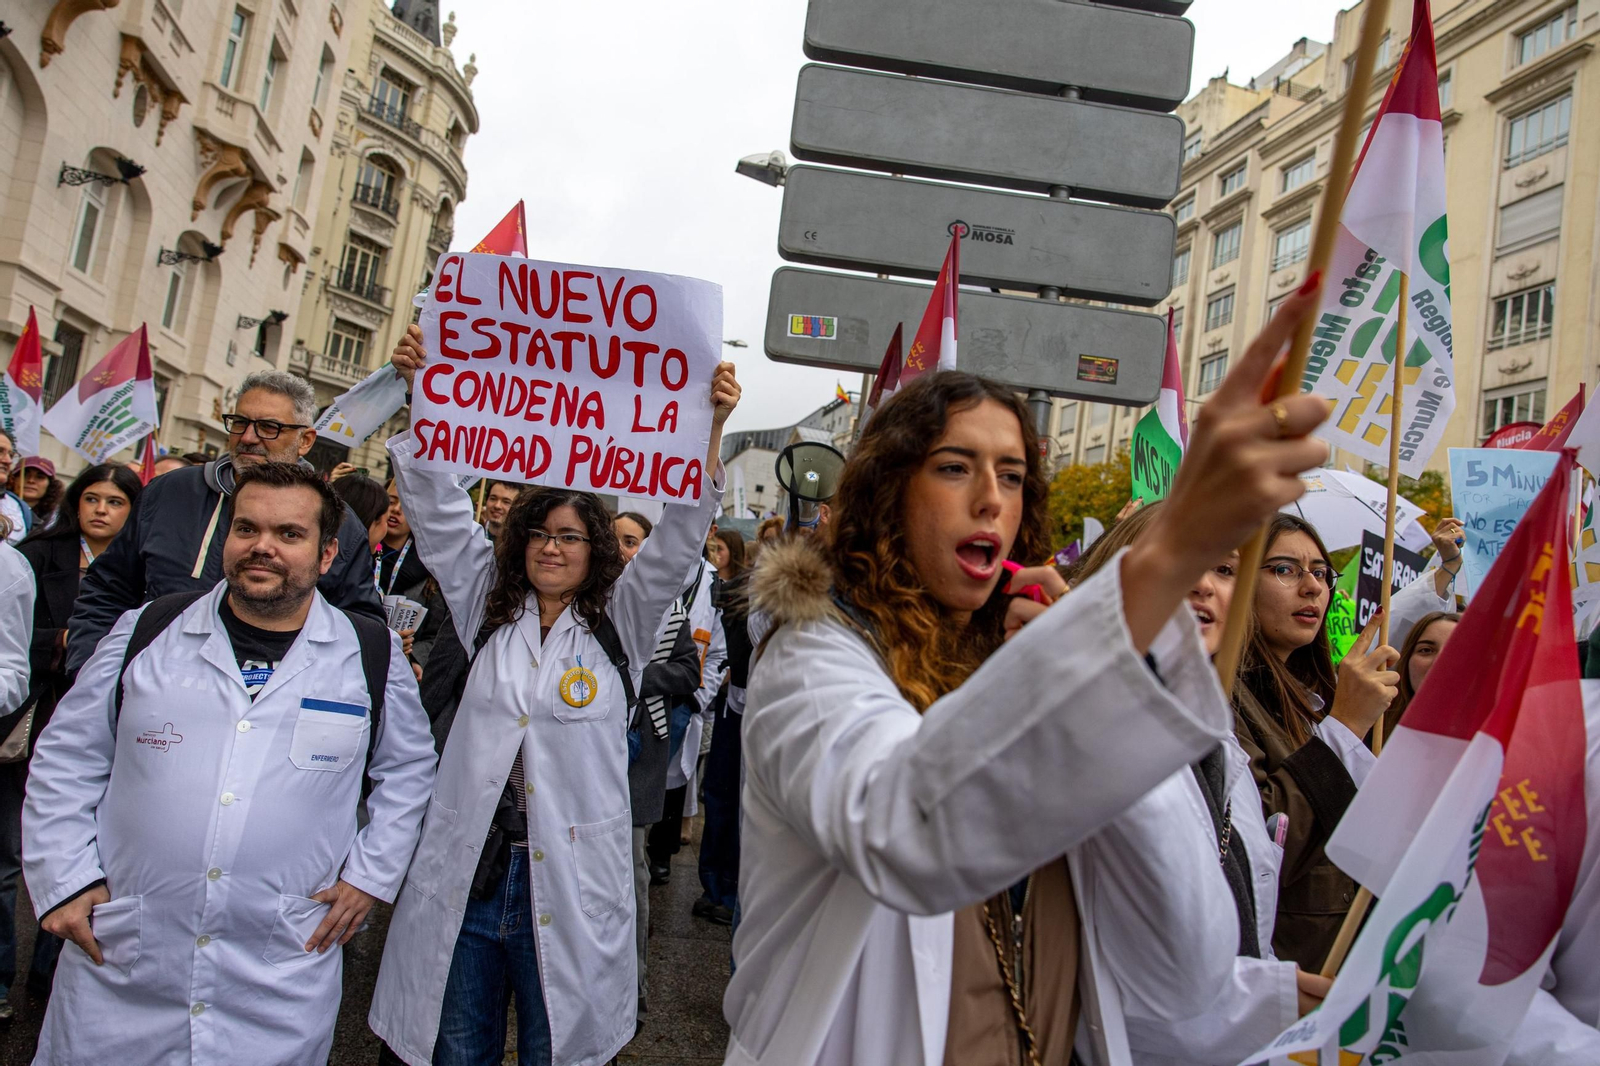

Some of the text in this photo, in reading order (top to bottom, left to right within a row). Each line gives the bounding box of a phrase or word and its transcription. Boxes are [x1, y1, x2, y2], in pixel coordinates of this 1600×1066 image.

[971, 231, 1014, 245] MOSA
[435, 256, 657, 332] EL NUEVO
[439, 311, 689, 391] ESTATUTO
[422, 364, 679, 434] CONDENA LA
[413, 418, 701, 500] SANIDAD PÚBLICA
[1133, 432, 1160, 496] MIS
[1465, 460, 1489, 487] 5
[1464, 511, 1487, 531] NO
[136, 736, 167, 746] Murciano
